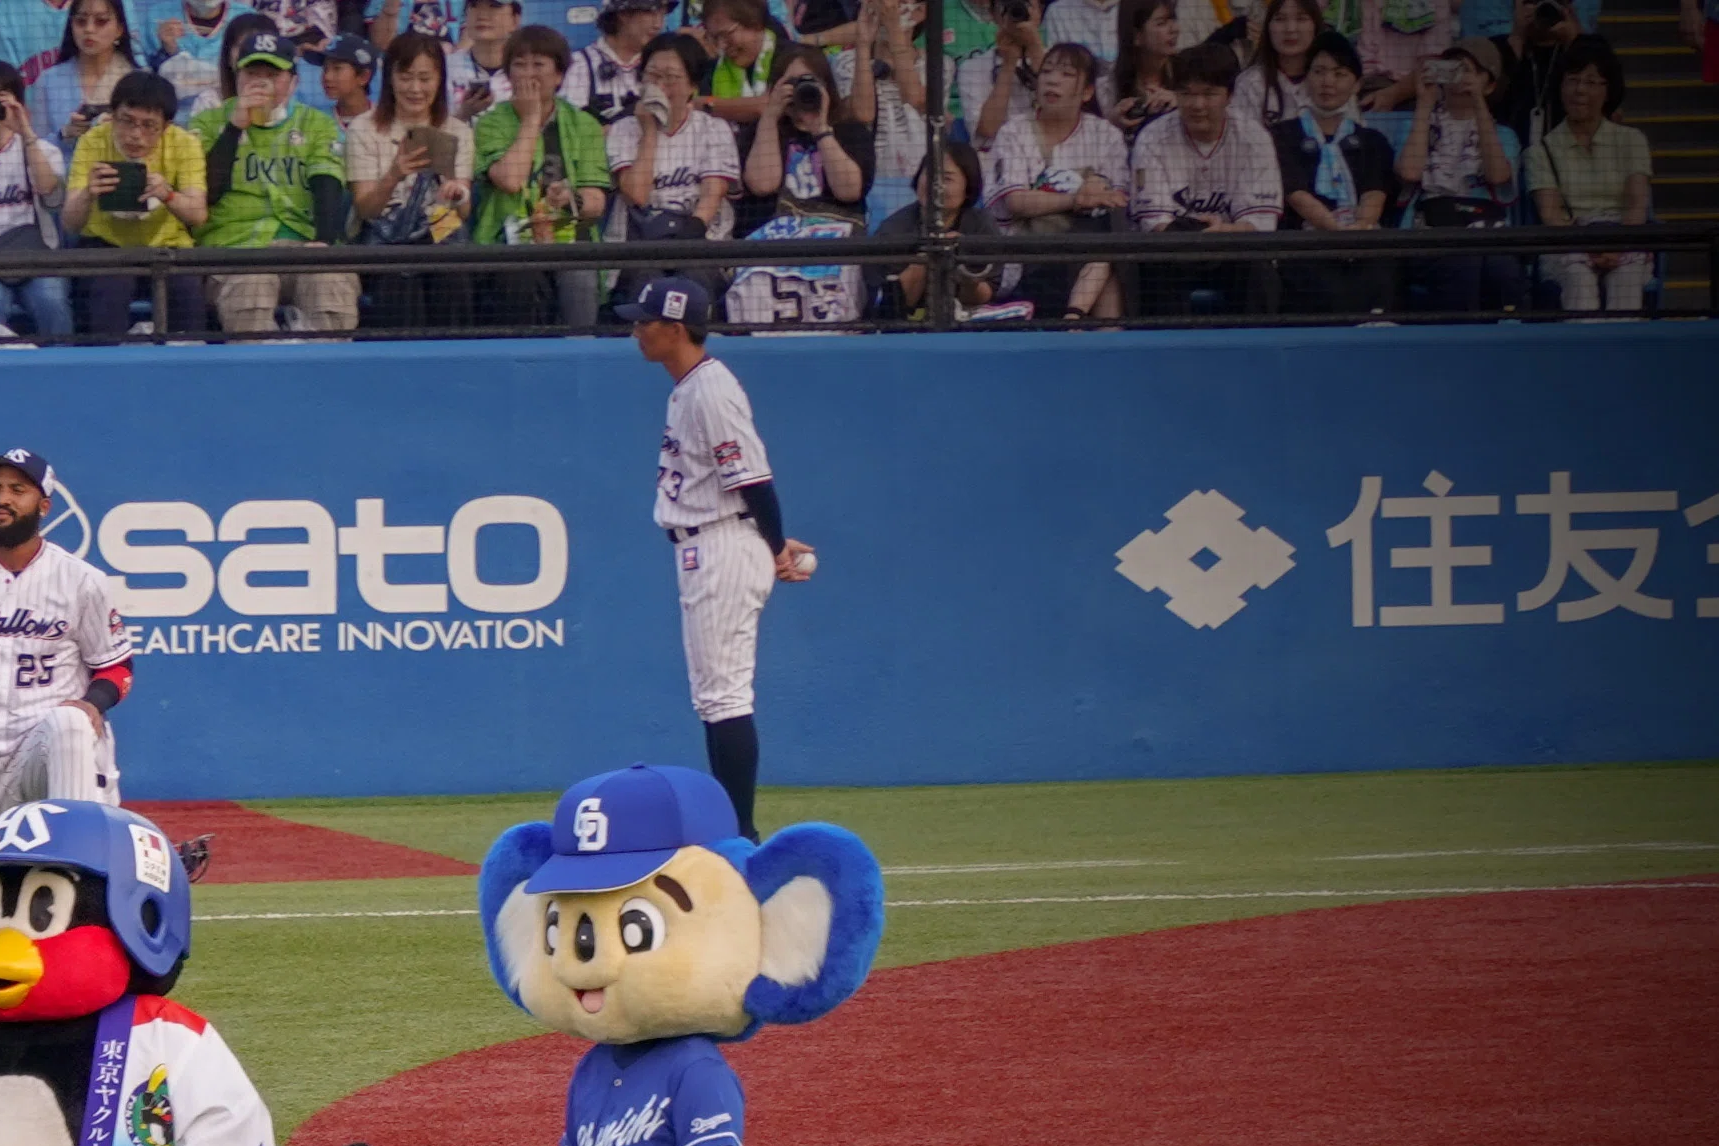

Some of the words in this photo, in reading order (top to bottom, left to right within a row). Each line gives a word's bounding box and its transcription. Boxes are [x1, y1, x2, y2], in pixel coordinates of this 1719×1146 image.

[97, 495, 569, 618] sato
[125, 622, 321, 655] EALTHCARE
[337, 618, 565, 652] INNOVATION
[15, 653, 57, 689] 25
